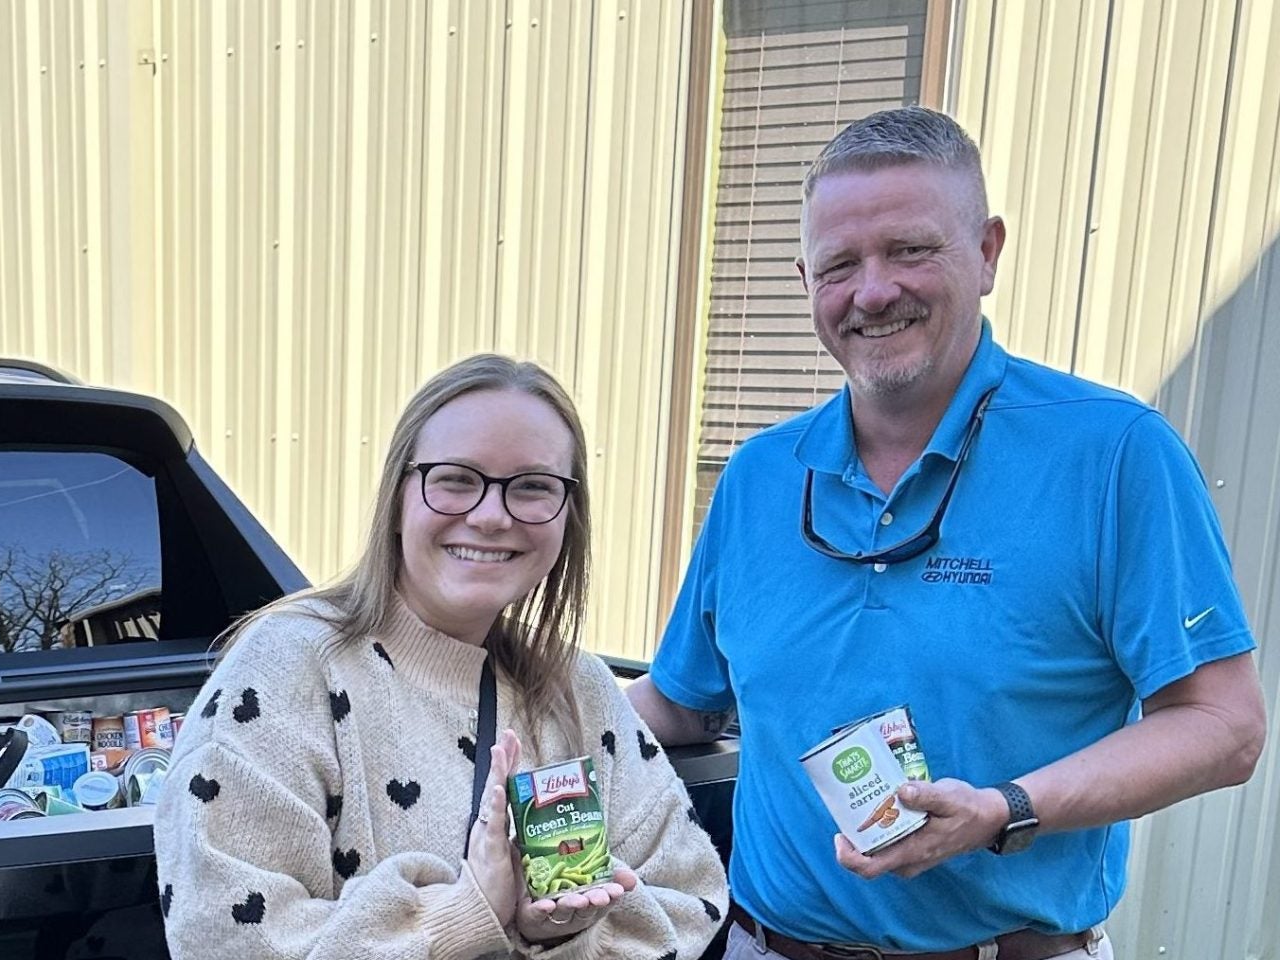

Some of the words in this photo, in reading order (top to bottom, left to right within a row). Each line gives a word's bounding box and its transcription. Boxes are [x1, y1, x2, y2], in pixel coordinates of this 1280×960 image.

[926, 557, 993, 570] MITCHELL
[942, 571, 992, 585] HYUNDAI
[541, 773, 580, 793] Libby's
[848, 773, 883, 800] sliced
[850, 783, 891, 810] carrots
[556, 803, 575, 813] Cut
[526, 817, 568, 837] Green
